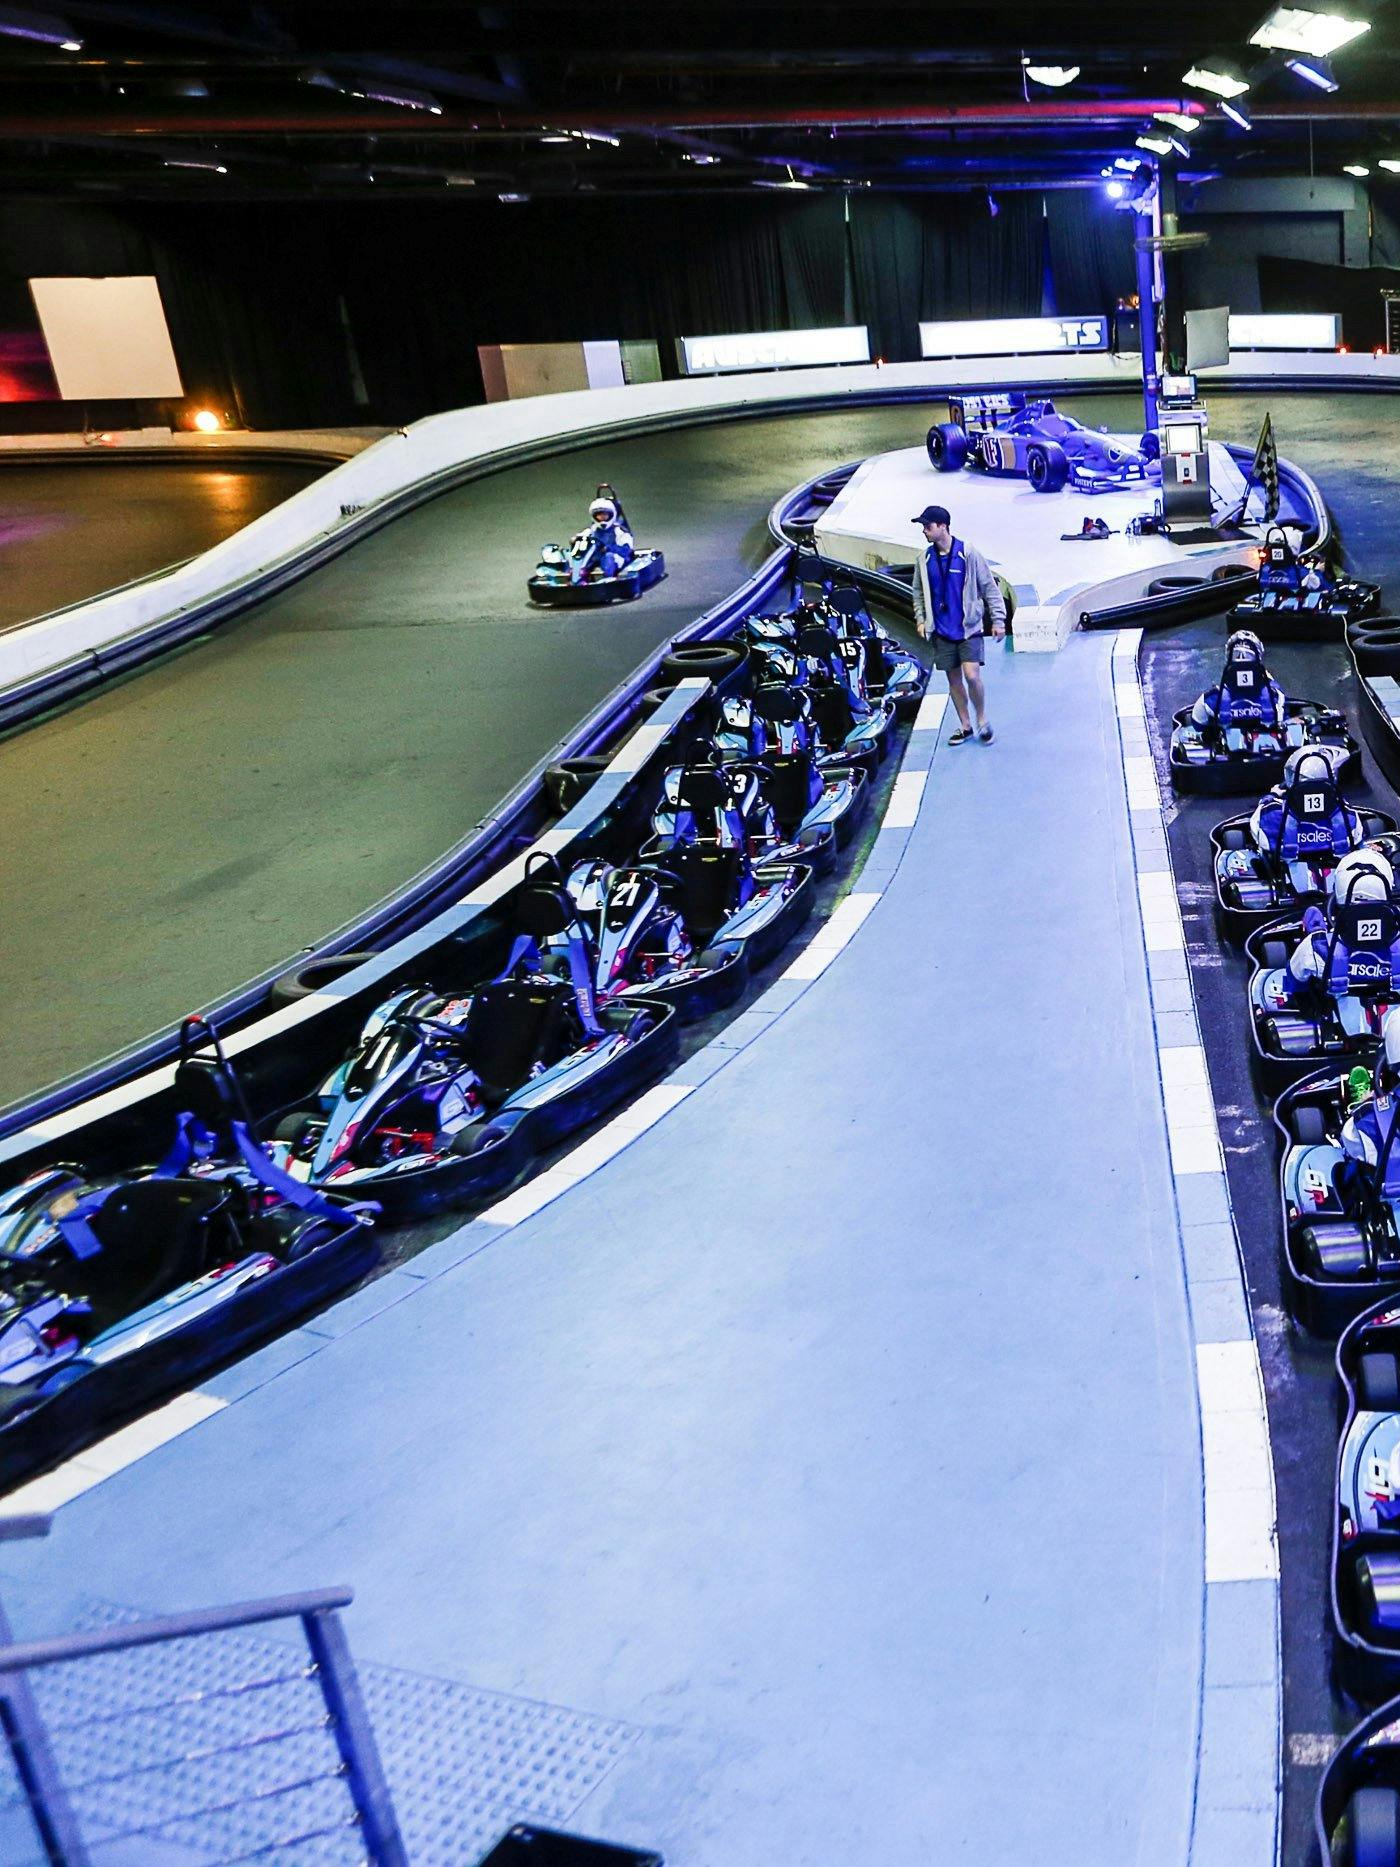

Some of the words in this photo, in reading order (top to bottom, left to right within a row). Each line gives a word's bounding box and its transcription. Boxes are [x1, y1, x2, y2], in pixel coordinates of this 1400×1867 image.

[1273, 550, 1282, 558] 20
[839, 642, 857, 657] 15
[1242, 673, 1249, 684] 3
[1307, 796, 1321, 810] 13
[1297, 830, 1332, 844] rsales
[609, 882, 641, 907] 21
[1361, 923, 1378, 937] 22
